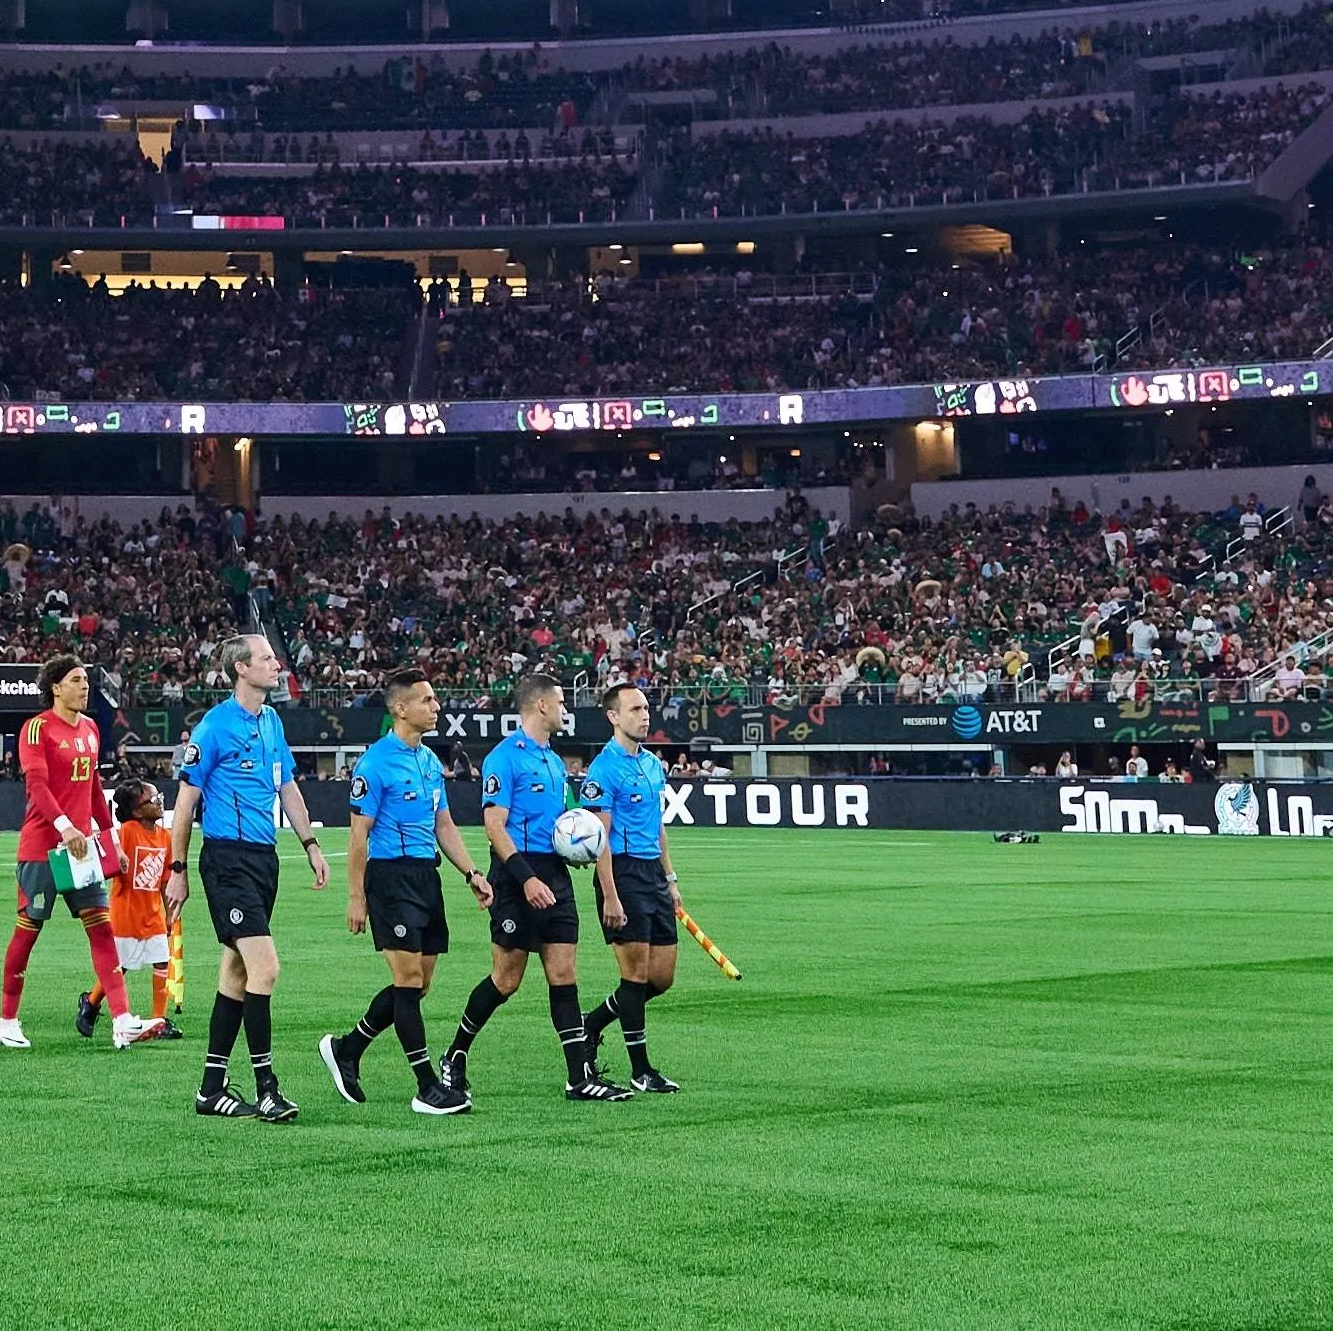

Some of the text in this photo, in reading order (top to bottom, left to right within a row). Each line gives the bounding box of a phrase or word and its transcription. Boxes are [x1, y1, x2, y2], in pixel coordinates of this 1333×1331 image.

[986, 709, 1042, 733] AT&T
[71, 757, 92, 782] 13
[664, 783, 869, 826] XTOUR
